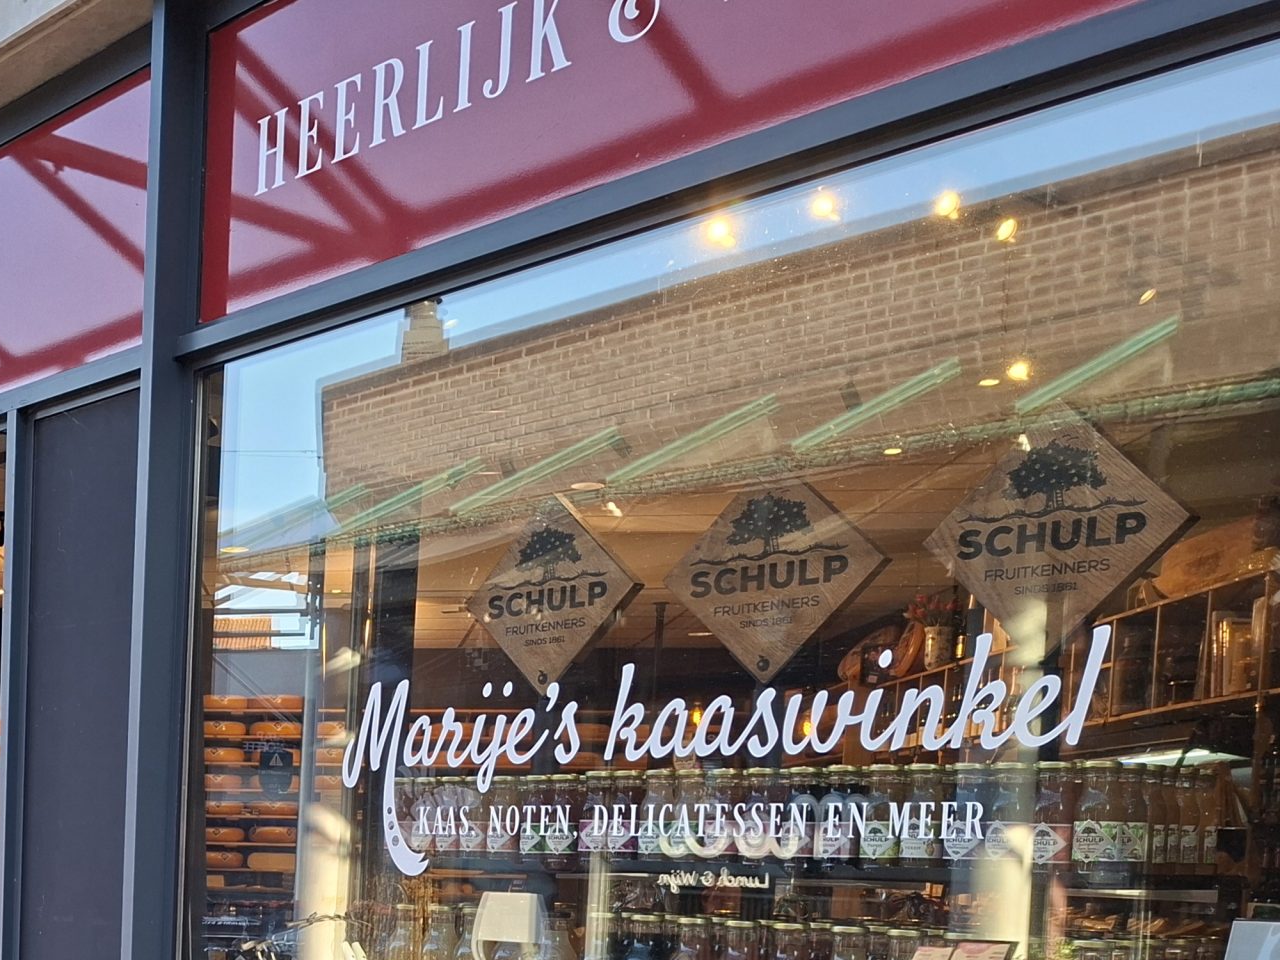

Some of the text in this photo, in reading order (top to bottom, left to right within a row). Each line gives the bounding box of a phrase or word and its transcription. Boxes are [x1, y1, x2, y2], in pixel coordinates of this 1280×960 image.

[254, 0, 572, 196] HEERLIJK
[957, 512, 1148, 561] SCHULP
[689, 554, 849, 599] SCHULP
[983, 558, 1111, 583] FRUITKENNERS
[487, 580, 608, 621] SCHULP
[713, 595, 821, 618] FRUITKENNERS
[505, 617, 587, 637] FRUITKENNERS
[342, 679, 581, 877] Marije's
[604, 625, 1112, 762] kaaswinkel
[489, 804, 578, 839] NOTEN,
[592, 803, 808, 838] DELICATESSEN
[825, 802, 869, 838] EN
[888, 801, 985, 840] MEER
